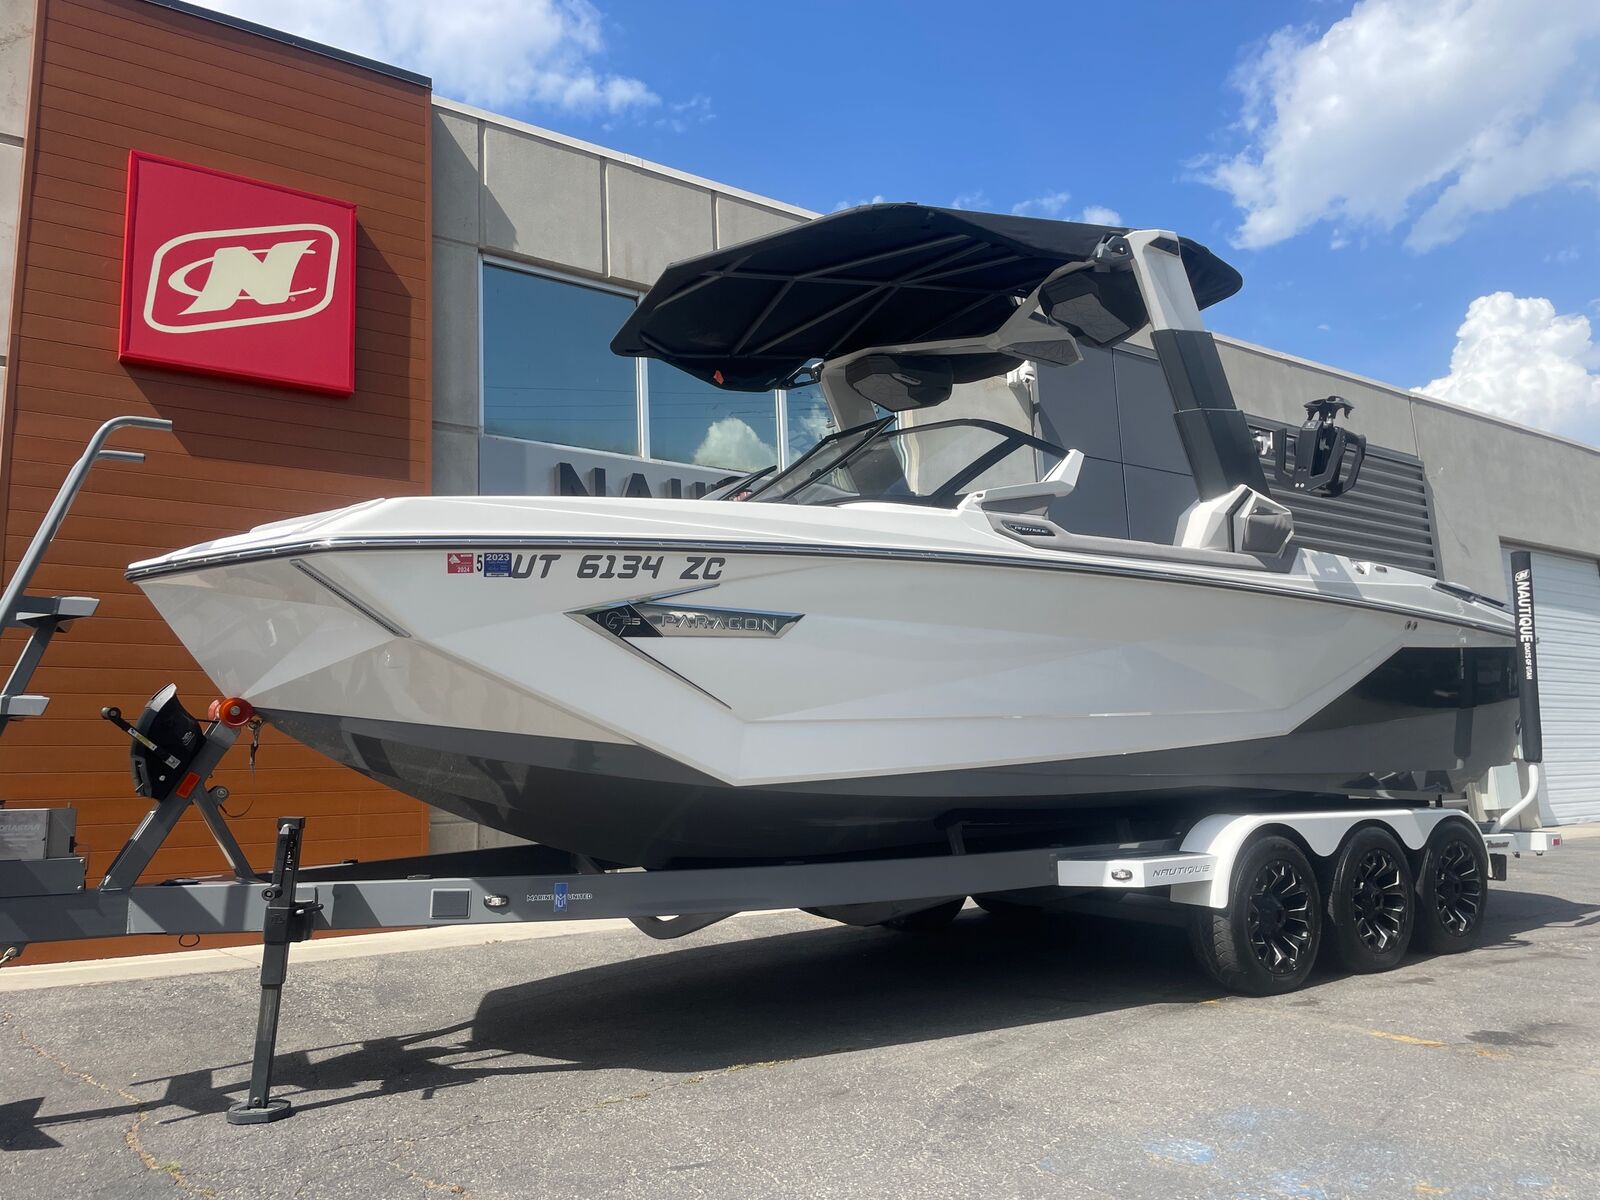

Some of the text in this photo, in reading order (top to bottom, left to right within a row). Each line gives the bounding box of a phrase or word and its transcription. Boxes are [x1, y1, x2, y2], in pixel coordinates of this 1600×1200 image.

[476, 554, 483, 572] 5
[486, 553, 510, 561] 2023
[511, 554, 561, 579] UT
[577, 554, 664, 580] 6134
[680, 556, 726, 580] ZC
[1516, 581, 1534, 643] NAUTIQUE
[661, 613, 777, 632] PARAGON
[1152, 864, 1211, 878] NAUTIQUE
[526, 893, 554, 902] MARINE
[567, 892, 593, 901] UNITED
